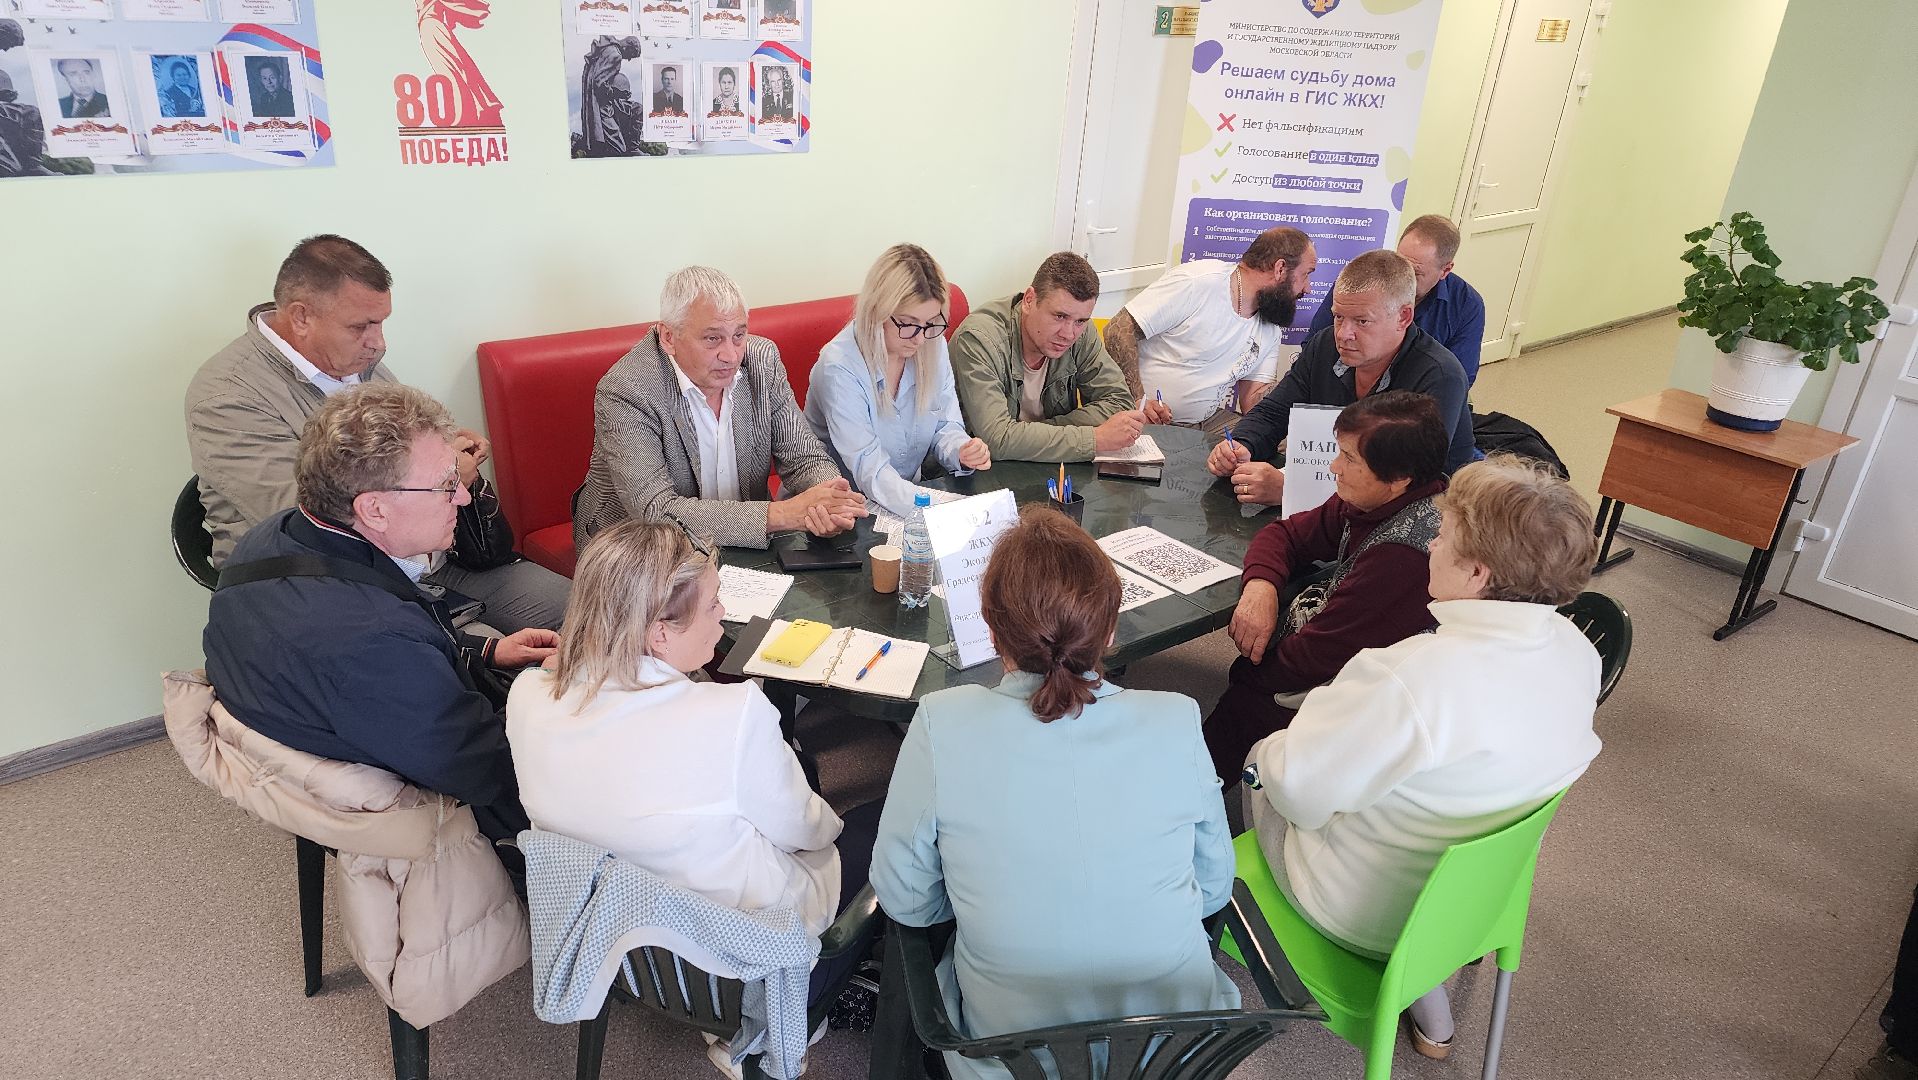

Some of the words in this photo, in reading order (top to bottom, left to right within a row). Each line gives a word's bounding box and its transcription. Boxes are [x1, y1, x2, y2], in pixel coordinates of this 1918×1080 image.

[1160, 10, 1169, 29] 2
[1229, 22, 1286, 33] МИНИСТЕРСТВО
[1288, 26, 1299, 34] ПО
[1300, 28, 1352, 38] СОДЕРЖАНИЮ
[1353, 31, 1400, 41] ТЕРРИТОРИЙ
[1227, 33, 1234, 41] И
[1234, 33, 1310, 47] ГОСУДАРСТВЕННОМУ
[1310, 39, 1362, 49] ЖИЛИЩНОМУ
[1363, 42, 1397, 52] НАДЗОРУ
[1269, 46, 1319, 57] МОСКОВСКОЙ
[1320, 50, 1353, 59] ОБЛАСТИ
[1220, 61, 1286, 80] Решаем
[1290, 69, 1350, 88] судьбу
[1352, 74, 1396, 88] дома
[394, 74, 456, 127] 80
[1224, 87, 1285, 102] онлайн
[1290, 92, 1300, 103] в
[1305, 90, 1339, 106] ГИС
[1342, 92, 1385, 109] ЖКХ!
[1242, 118, 1264, 130] Нет
[1265, 119, 1364, 136] фальсификациям
[400, 136, 509, 166] ПОБЕДА!
[1237, 145, 1309, 160] Голосование
[1310, 152, 1316, 161] в
[1318, 153, 1347, 164] один
[1348, 154, 1378, 165] клик
[1232, 173, 1273, 187] Доступ
[1274, 176, 1287, 186] из
[1289, 177, 1327, 189] любой
[1328, 180, 1362, 191] точки
[1204, 207, 1225, 219] Как
[1226, 209, 1299, 223] организовать
[1300, 214, 1373, 228] голосование?
[1192, 226, 1199, 236] 1
[1293, 457, 1331, 467] ВОЛОКО
[1315, 471, 1337, 481] ПАТ
[982, 509, 992, 526] 2
